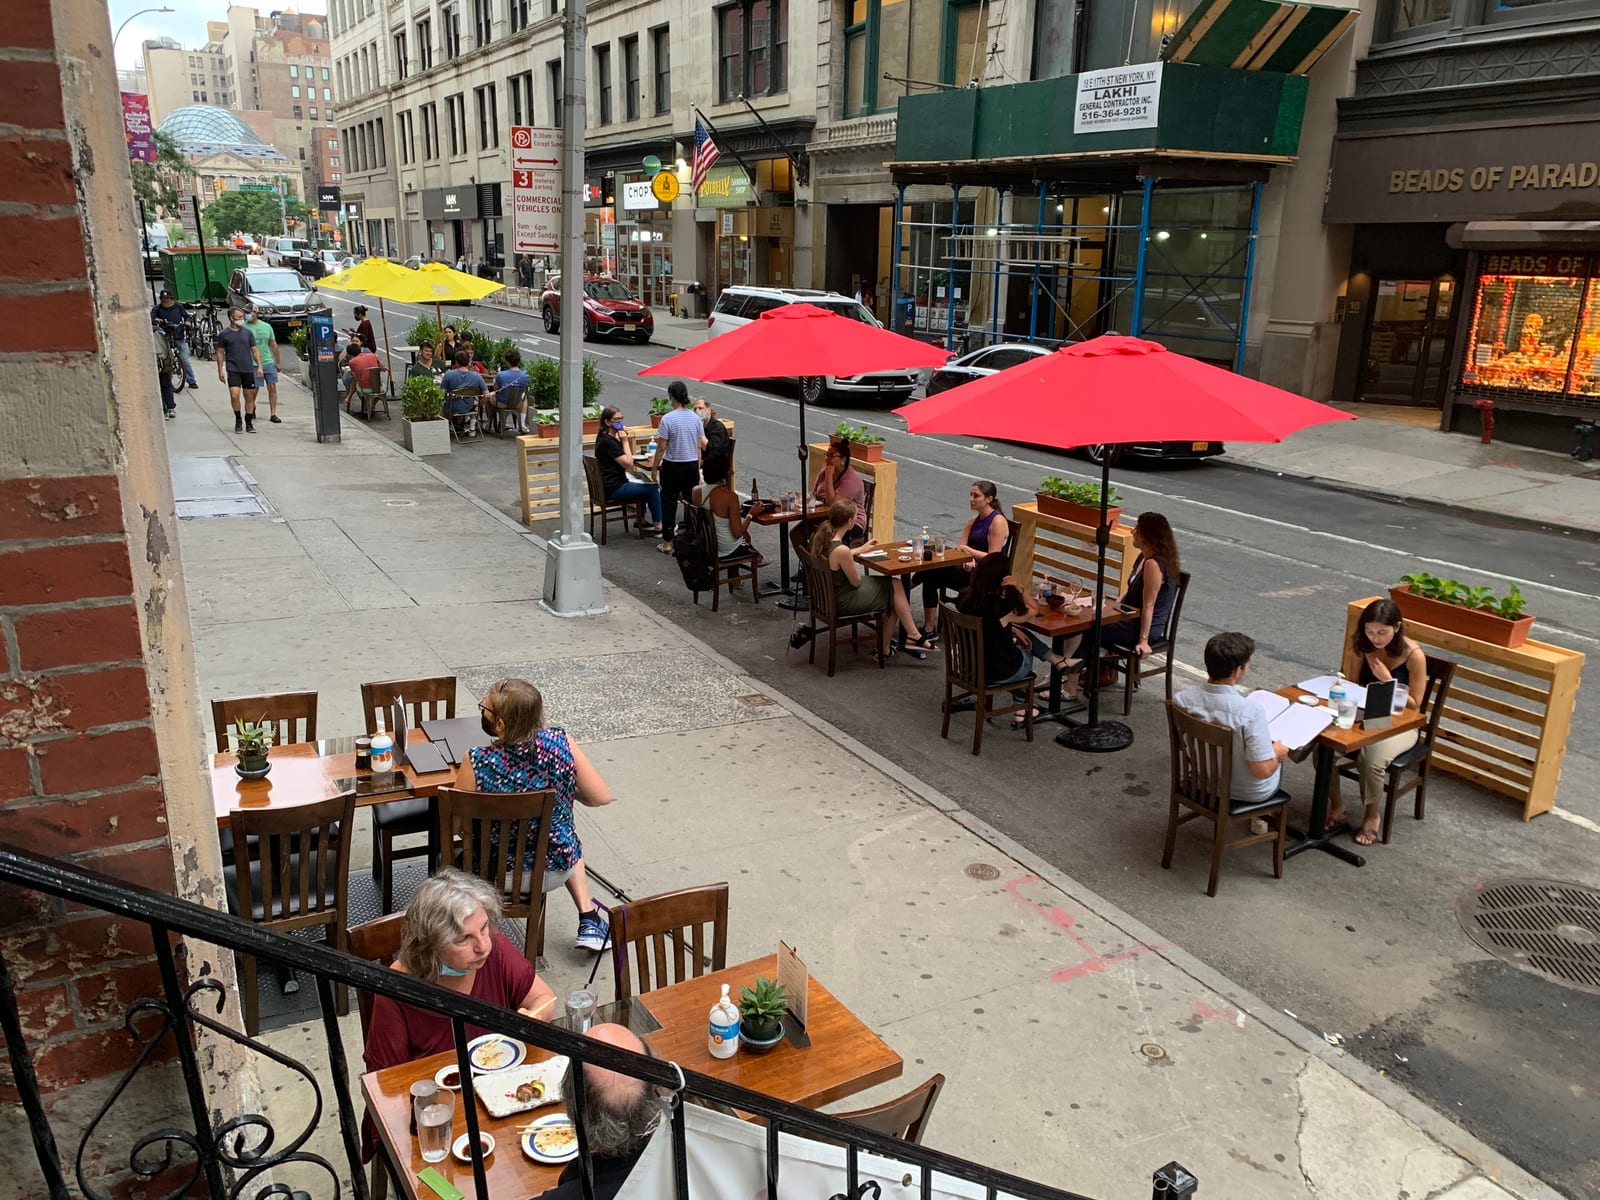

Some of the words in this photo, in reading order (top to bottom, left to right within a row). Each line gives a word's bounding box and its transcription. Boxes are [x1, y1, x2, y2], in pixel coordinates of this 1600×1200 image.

[1107, 75, 1114, 86] ST
[1115, 73, 1127, 85] NEW
[1146, 70, 1156, 81] NY
[1094, 86, 1137, 100] LAKHI
[1079, 101, 1103, 111] GENERAL
[1103, 97, 1140, 109] CONTRACTOR
[1141, 95, 1153, 104] INC.
[1081, 106, 1147, 120] 516-364-9281
[519, 171, 529, 187] 3
[1389, 167, 1465, 193] BEADS
[1470, 166, 1504, 190] OF
[1507, 162, 1600, 190] PARAD
[516, 195, 562, 205] COMMERCIAL
[516, 204, 550, 213] VEHICLES
[551, 206, 561, 214] ON
[516, 222, 529, 230] 9am
[534, 223, 548, 231] 6pm
[516, 231, 537, 239] Except
[537, 231, 558, 240] Sunday
[1487, 256, 1547, 273] BEADS
[1557, 256, 1585, 273] OF
[321, 326, 330, 338] P
